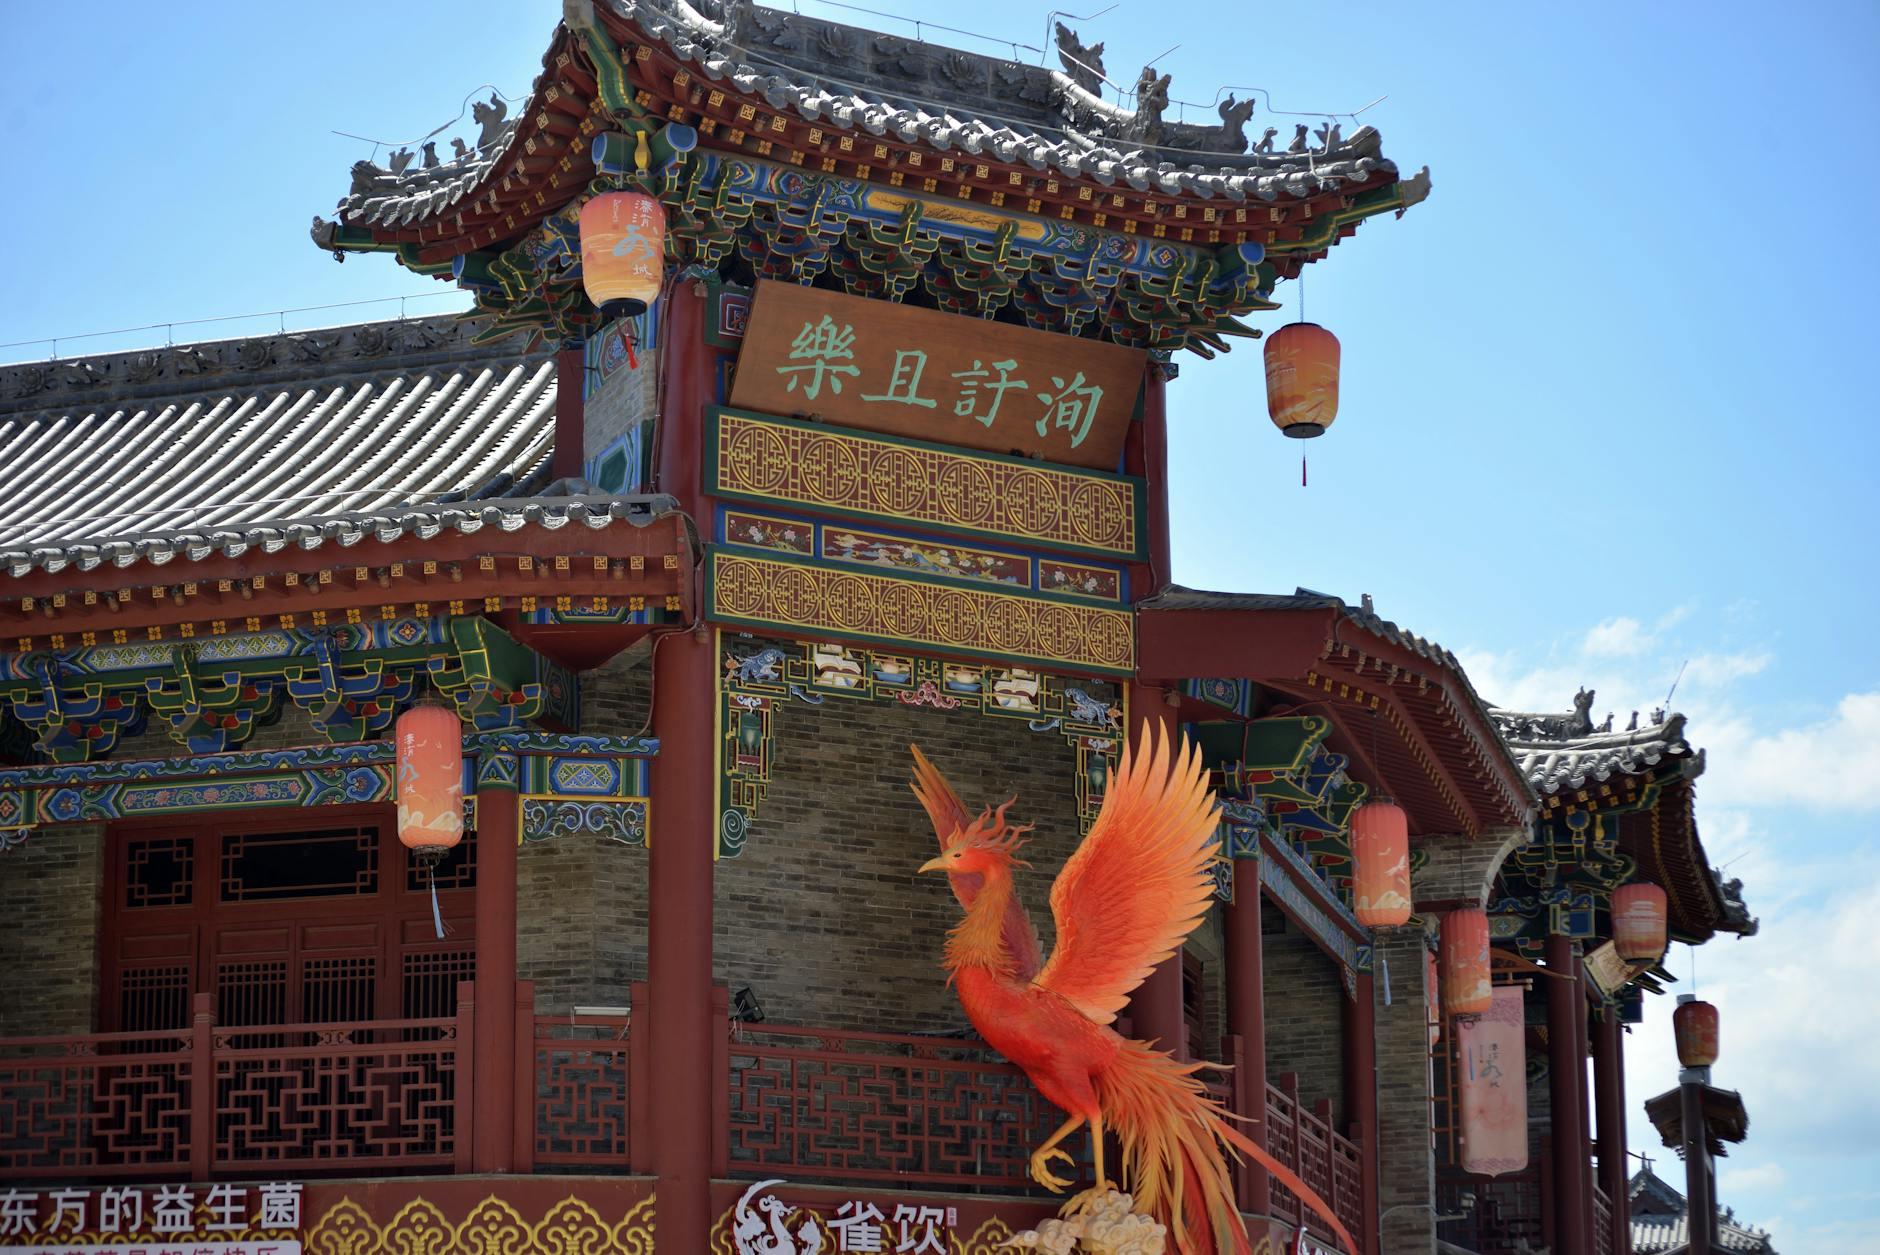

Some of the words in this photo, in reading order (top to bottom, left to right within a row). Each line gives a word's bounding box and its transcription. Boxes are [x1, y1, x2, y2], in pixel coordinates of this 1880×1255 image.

[0, 1182, 303, 1235] 东方的益生菌
